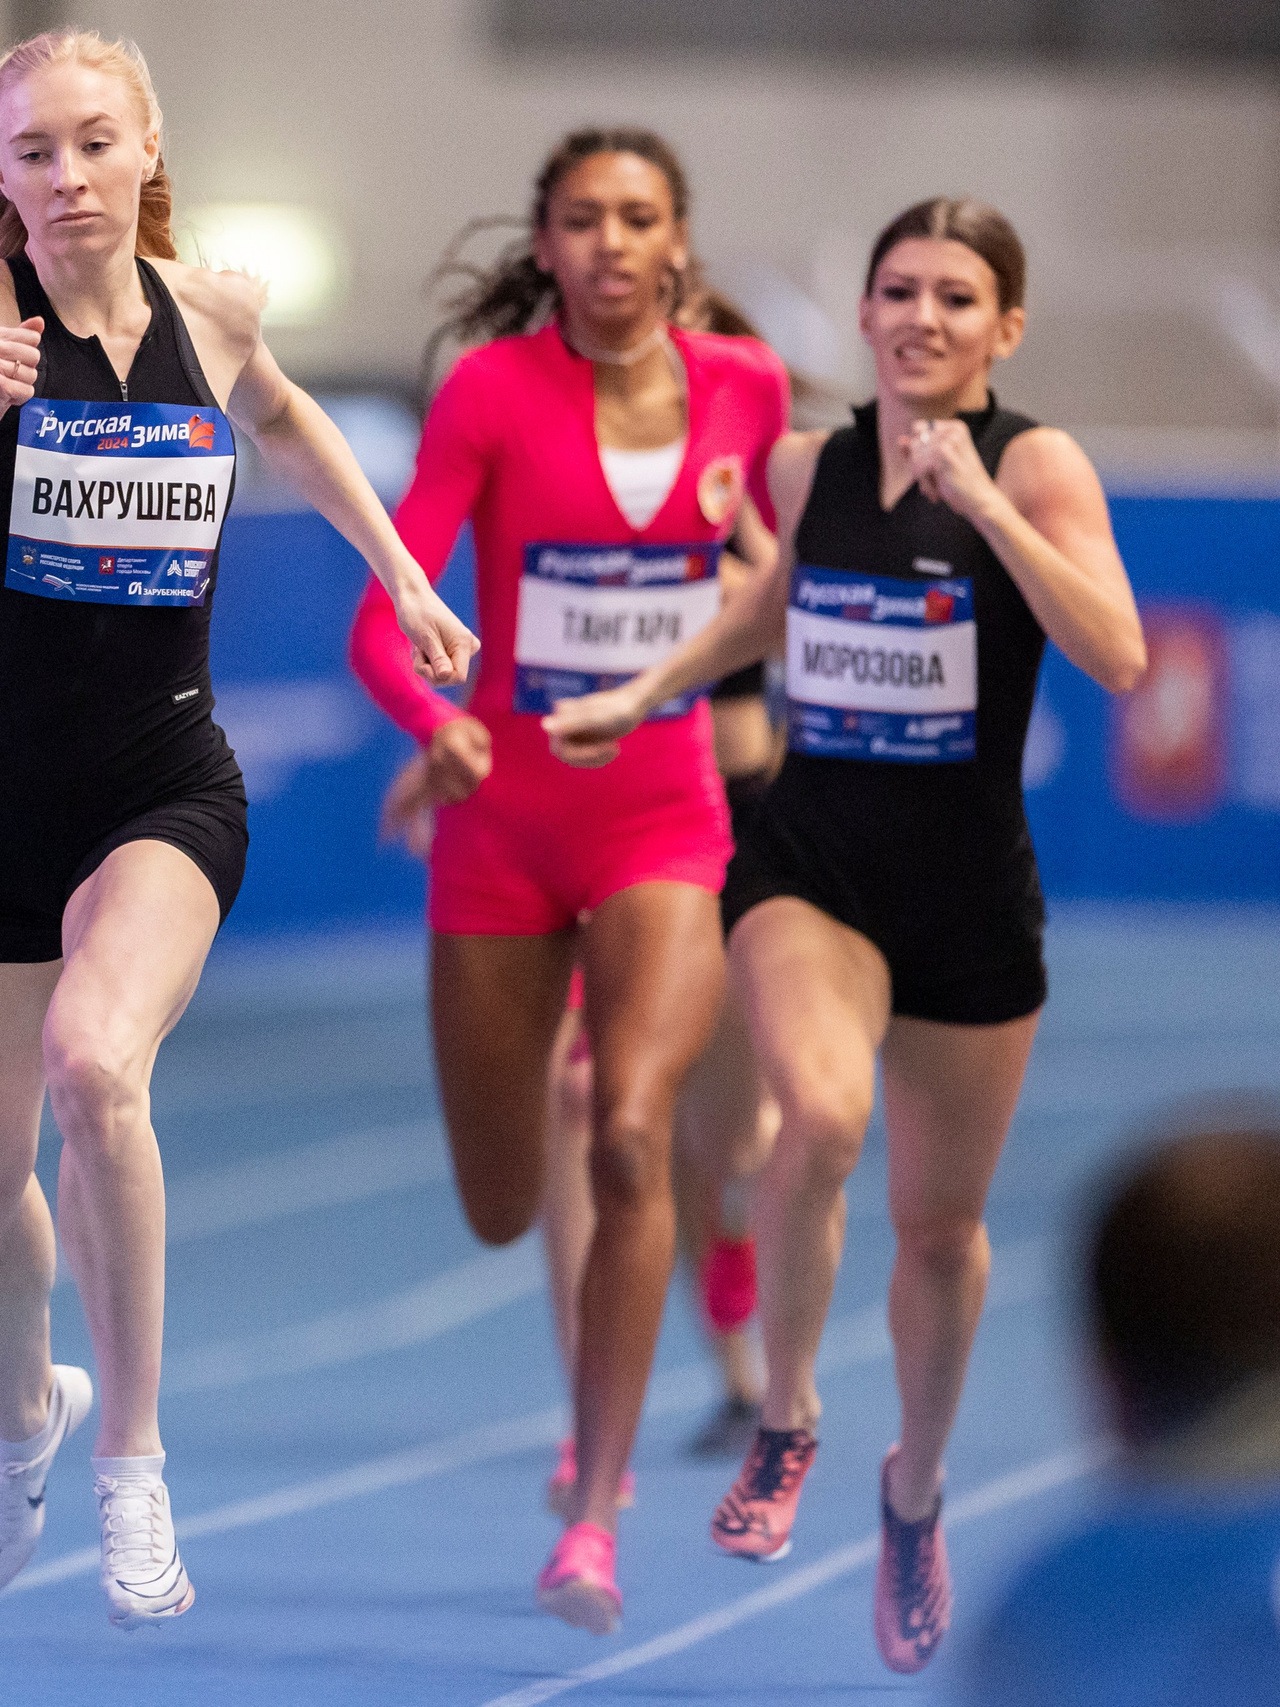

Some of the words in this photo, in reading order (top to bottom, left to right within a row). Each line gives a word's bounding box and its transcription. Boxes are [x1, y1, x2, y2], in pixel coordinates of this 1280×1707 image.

[39, 415, 132, 443] Русская
[131, 423, 190, 448] Зима
[97, 438, 129, 450] 2024
[32, 477, 216, 523] ВАХРУШЕВА
[803, 641, 945, 689] МОРОЗОВА
